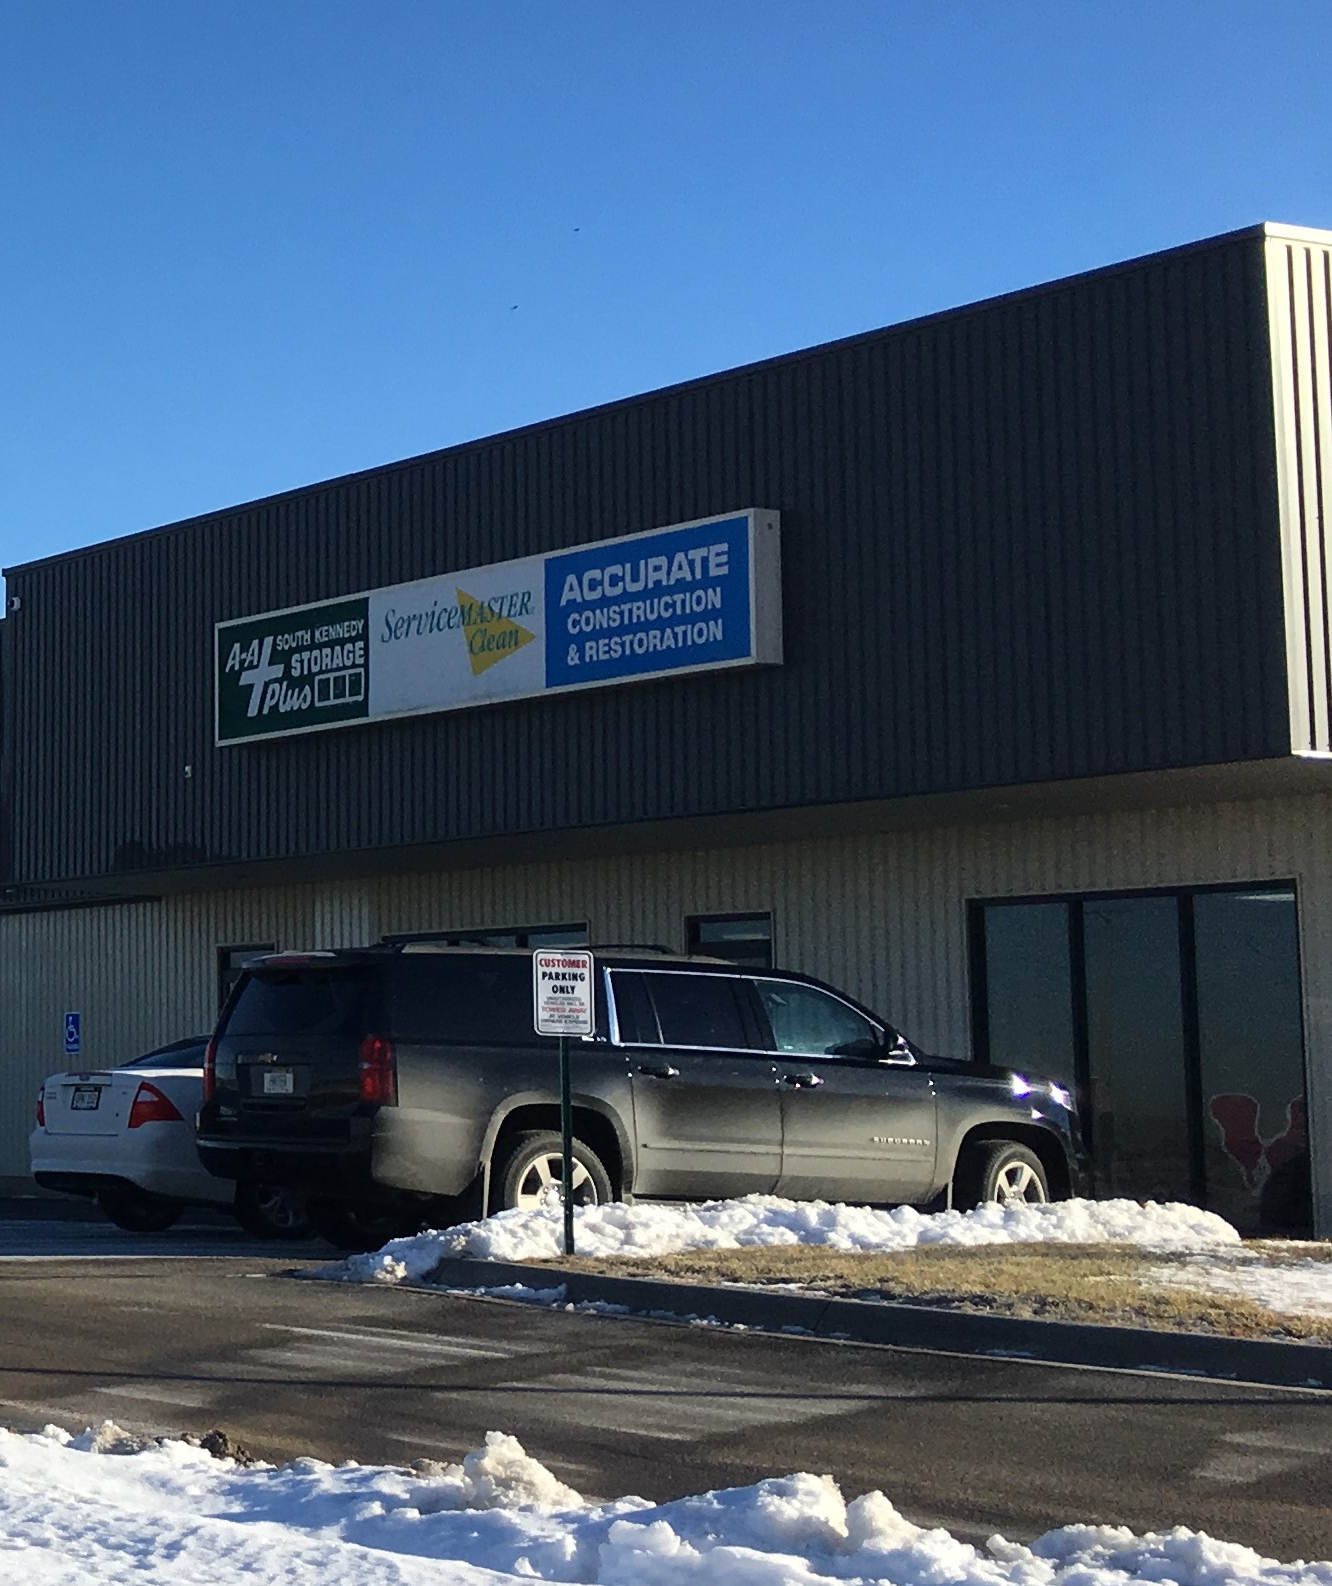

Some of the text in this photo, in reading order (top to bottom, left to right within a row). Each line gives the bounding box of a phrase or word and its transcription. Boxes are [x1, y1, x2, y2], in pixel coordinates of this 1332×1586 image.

[559, 542, 729, 607] ACCURATE
[380, 590, 532, 644] ServiceMASTER
[566, 586, 722, 635] CONSTRUCTION
[276, 618, 365, 651] SOUTH KENNEDY
[468, 628, 520, 656] Clean
[566, 618, 723, 667] & RESTORATION
[290, 640, 365, 677] STORAGE
[539, 958, 587, 968] CUSTOMER
[542, 971, 585, 982] PARKING
[552, 985, 575, 994] ONLY
